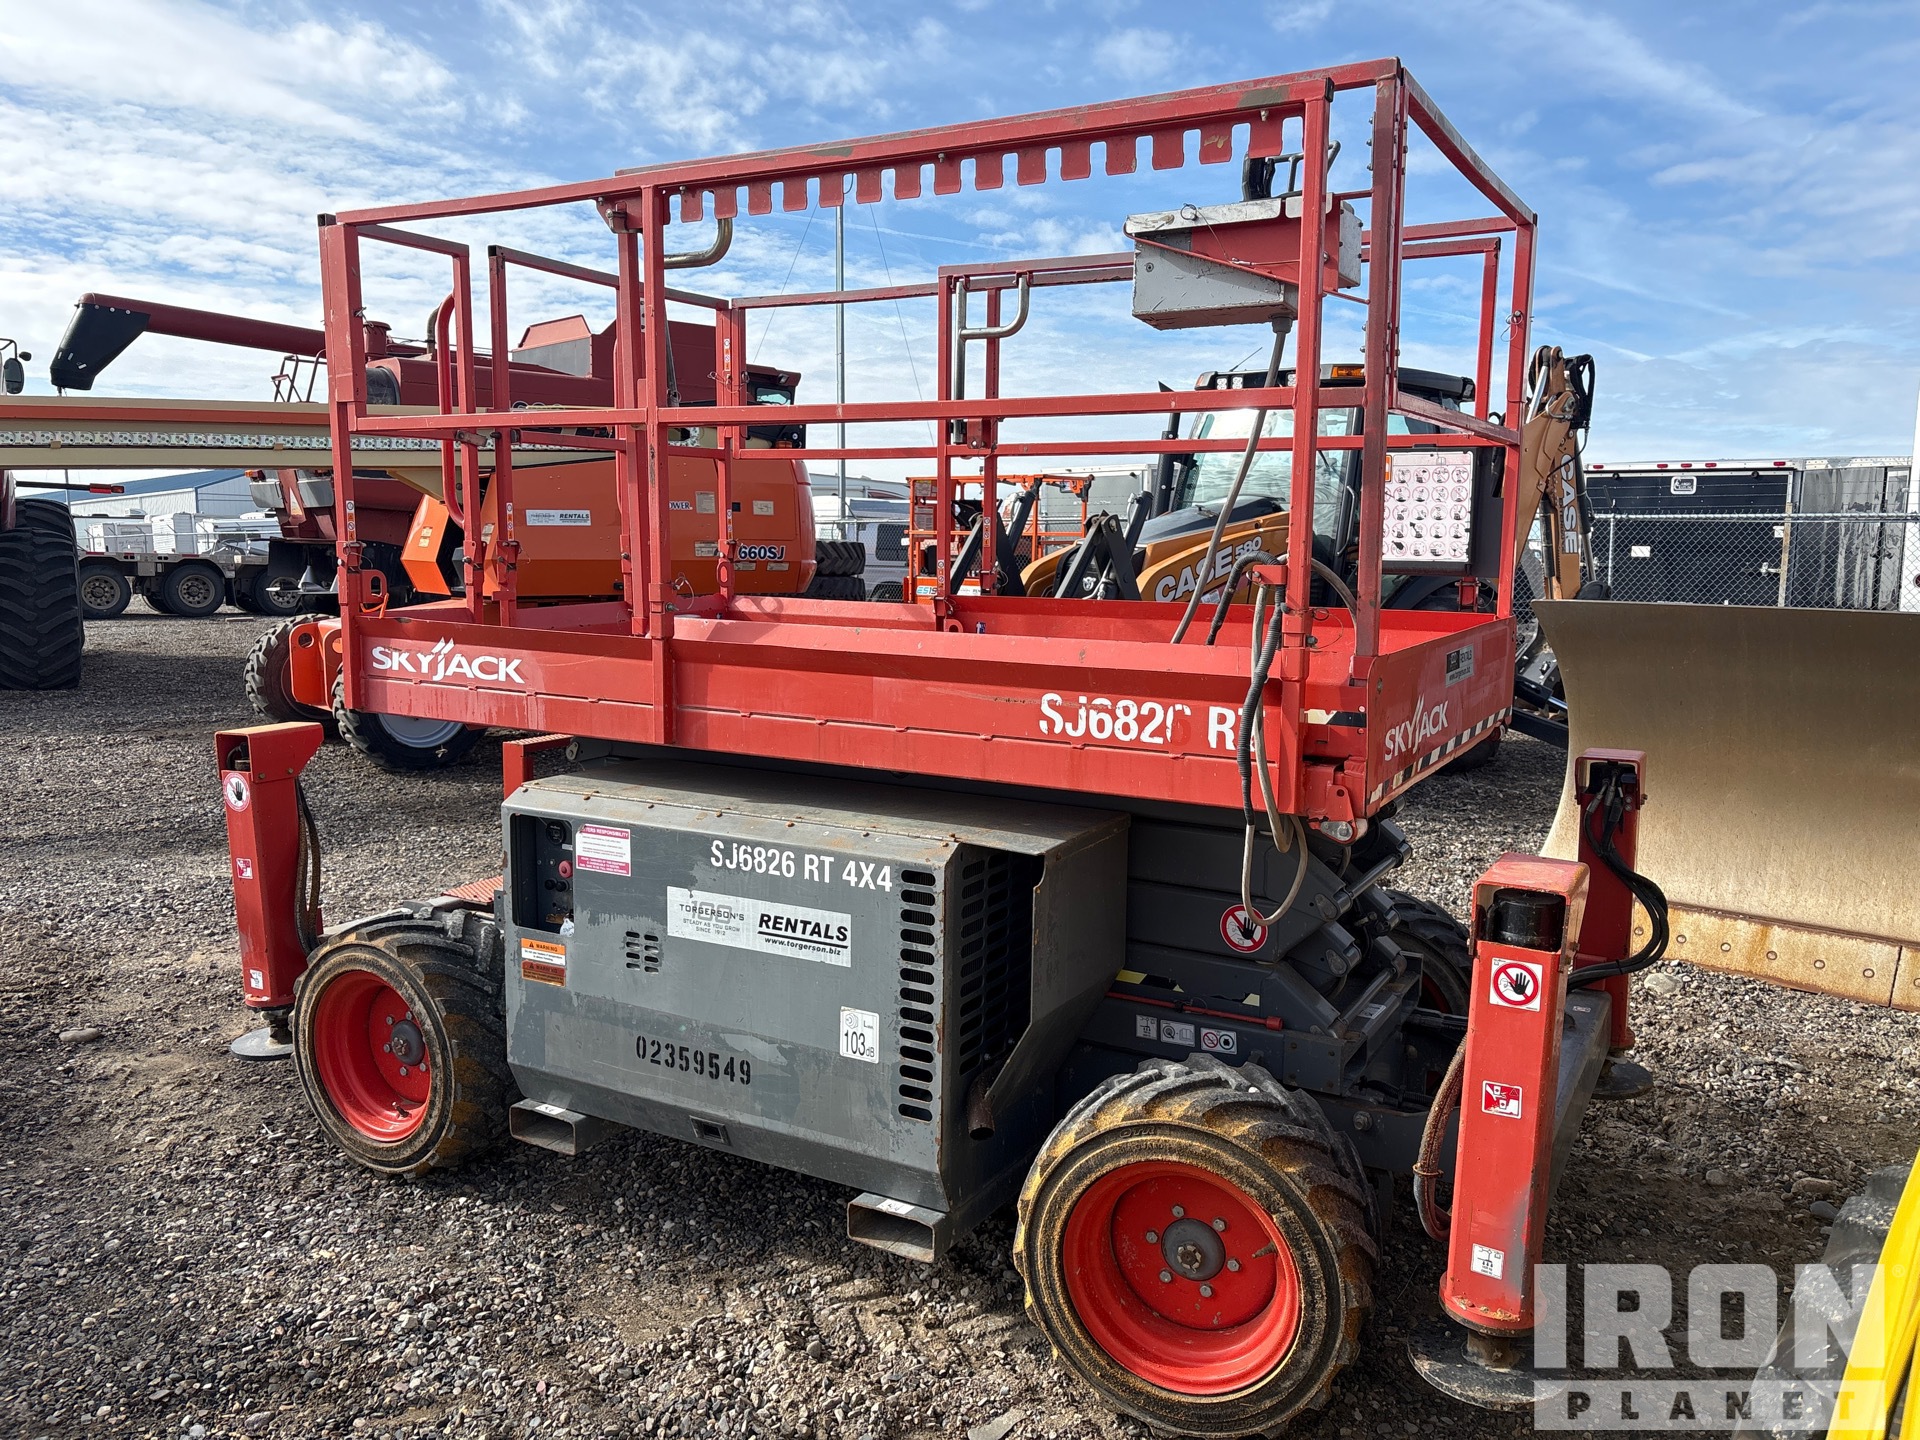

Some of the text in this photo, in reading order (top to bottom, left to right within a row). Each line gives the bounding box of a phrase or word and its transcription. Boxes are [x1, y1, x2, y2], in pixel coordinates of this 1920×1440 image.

[1561, 454, 1578, 553] CASE
[738, 544, 785, 560] 660SJ
[1155, 536, 1262, 603] CASE 580
[372, 637, 525, 684] SKYJACK
[1384, 693, 1449, 761] SKYJACK
[711, 840, 892, 892] SJ6826 RT 4X4
[679, 904, 745, 921] TORGERSON'S
[683, 918, 702, 926] STEADY
[696, 926, 711, 934] SINCE
[758, 913, 848, 942] RENTALS
[536, 943, 558, 952] WARNING
[765, 937, 841, 955] www.torgerson.biz
[844, 1030, 865, 1056] 103
[636, 1035, 751, 1085] 02359549
